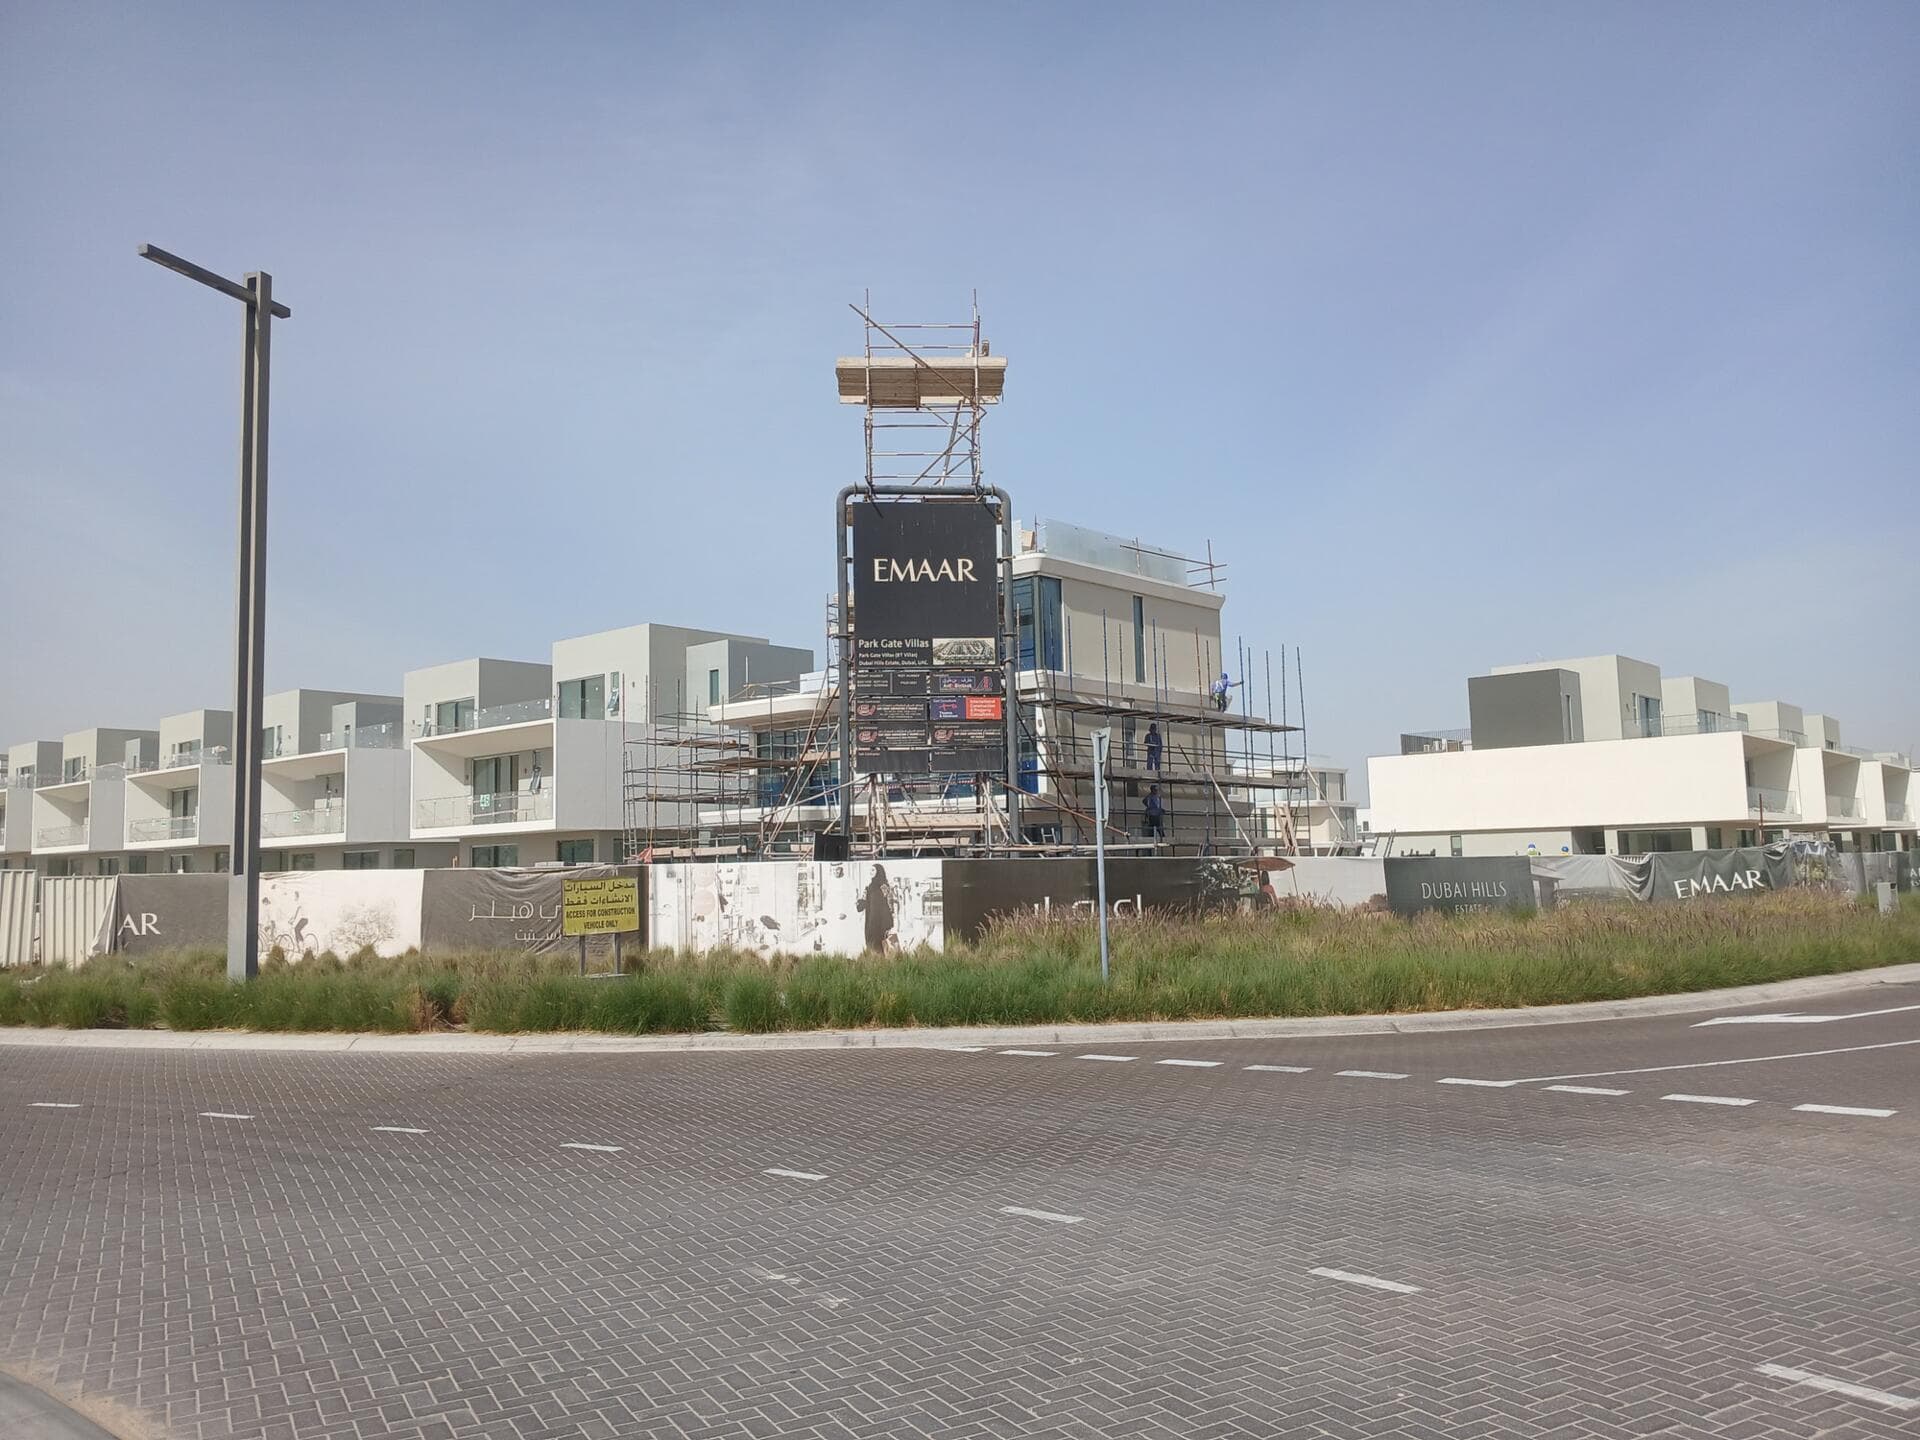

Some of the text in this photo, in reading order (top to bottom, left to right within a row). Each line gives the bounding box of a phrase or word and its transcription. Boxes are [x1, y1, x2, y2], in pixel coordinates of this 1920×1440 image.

[873, 558, 978, 582] EMAAR
[858, 638, 930, 649] Park Gate Villas
[564, 881, 636, 894] مدخل السيارات
[1421, 881, 1507, 899] DUBAI HILLS
[1673, 869, 1765, 900] EMAAR
[564, 895, 588, 907] فقط
[566, 910, 585, 919] ACCESS
[586, 909, 597, 918] FOR
[597, 907, 636, 917] CONSTRUCTION
[584, 920, 619, 930] VEHICLE ONLY
